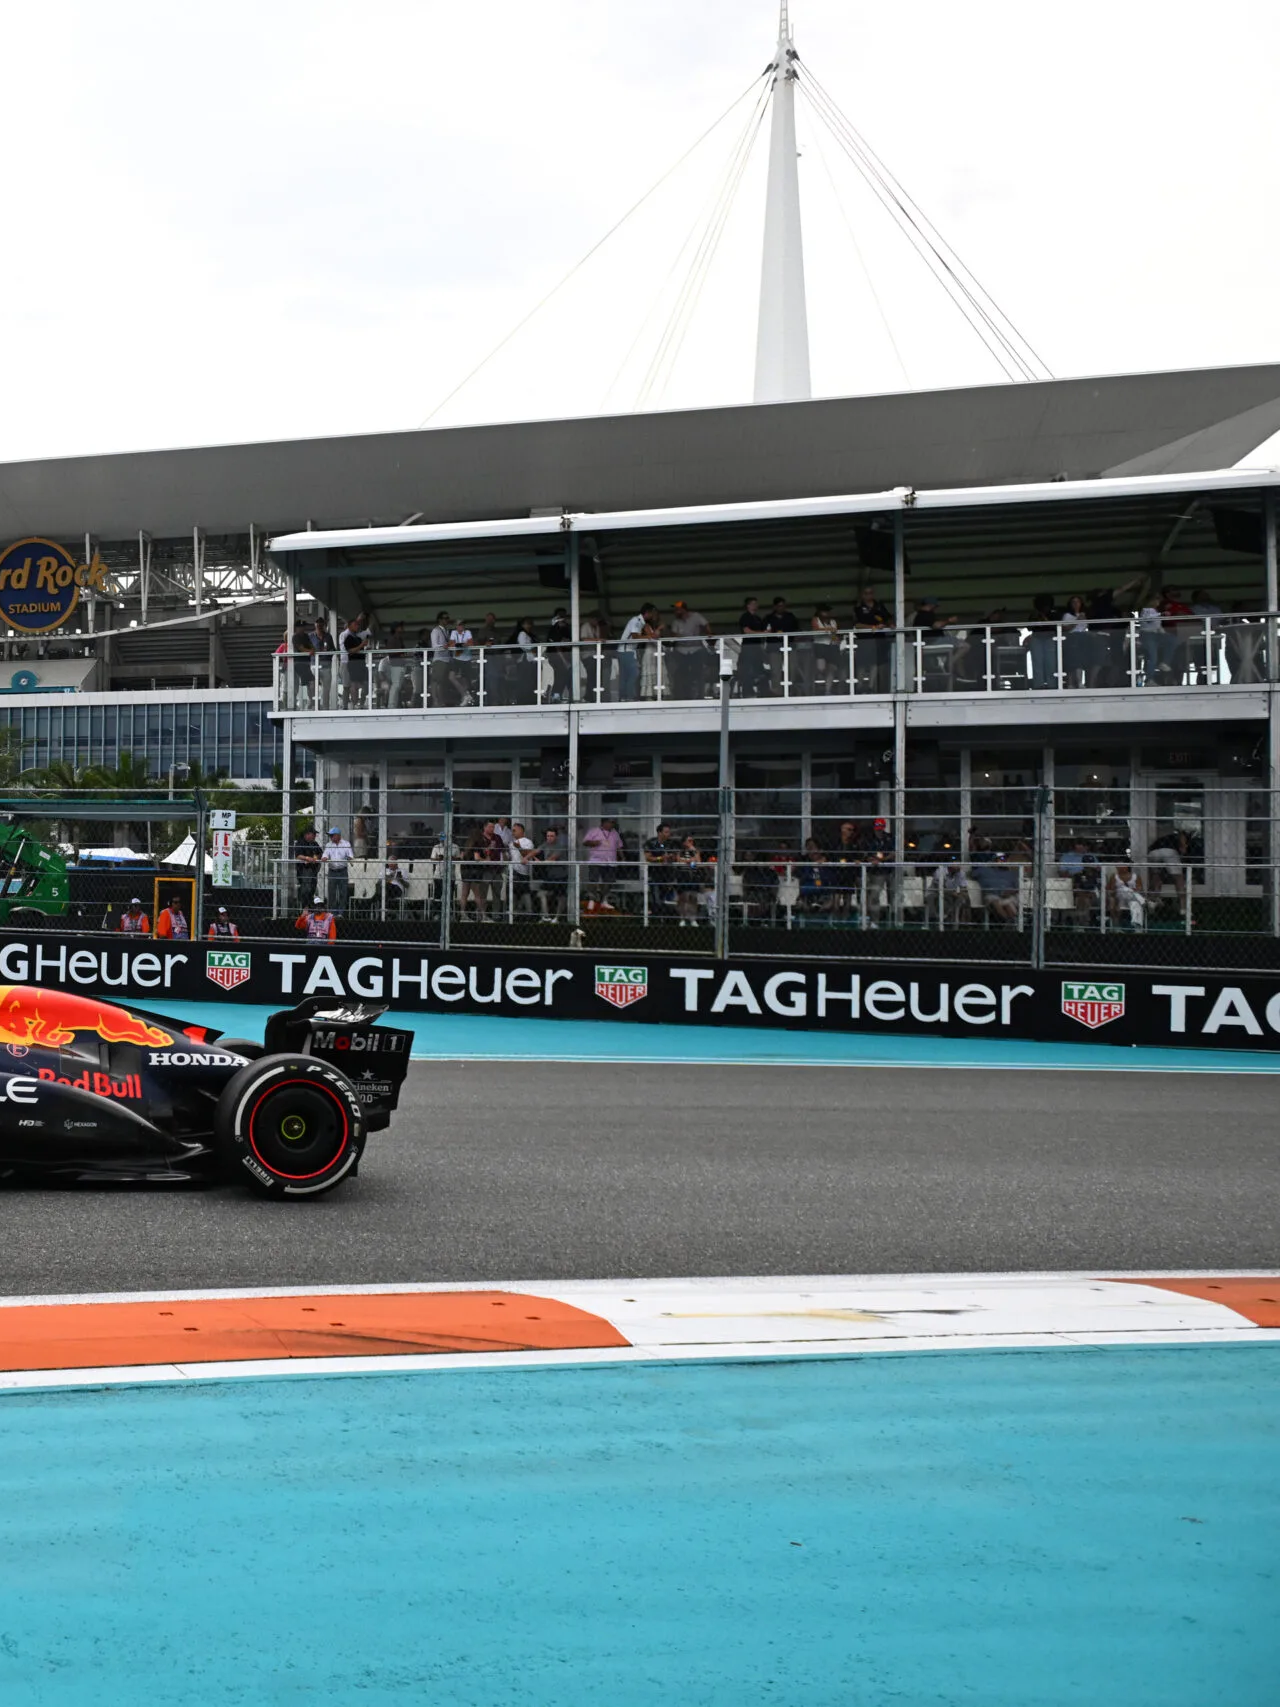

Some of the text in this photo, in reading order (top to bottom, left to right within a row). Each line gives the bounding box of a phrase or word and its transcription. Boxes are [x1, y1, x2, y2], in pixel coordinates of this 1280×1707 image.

[36, 553, 109, 595] Rock
[8, 602, 61, 614] STADIUM
[52, 887, 59, 897] 5
[210, 953, 247, 967] TAG
[208, 968, 248, 987] HEUER
[599, 968, 643, 983] TAG
[598, 984, 645, 1004] HEUER
[1067, 984, 1119, 1000] TAG
[1065, 1002, 1121, 1024] HEUER
[313, 1031, 398, 1052] Mobil 1
[148, 1051, 251, 1068] HONDA
[93, 1071, 143, 1099] Bull
[306, 1065, 362, 1118] P ZERO
[242, 1155, 275, 1187] PIRELLI
